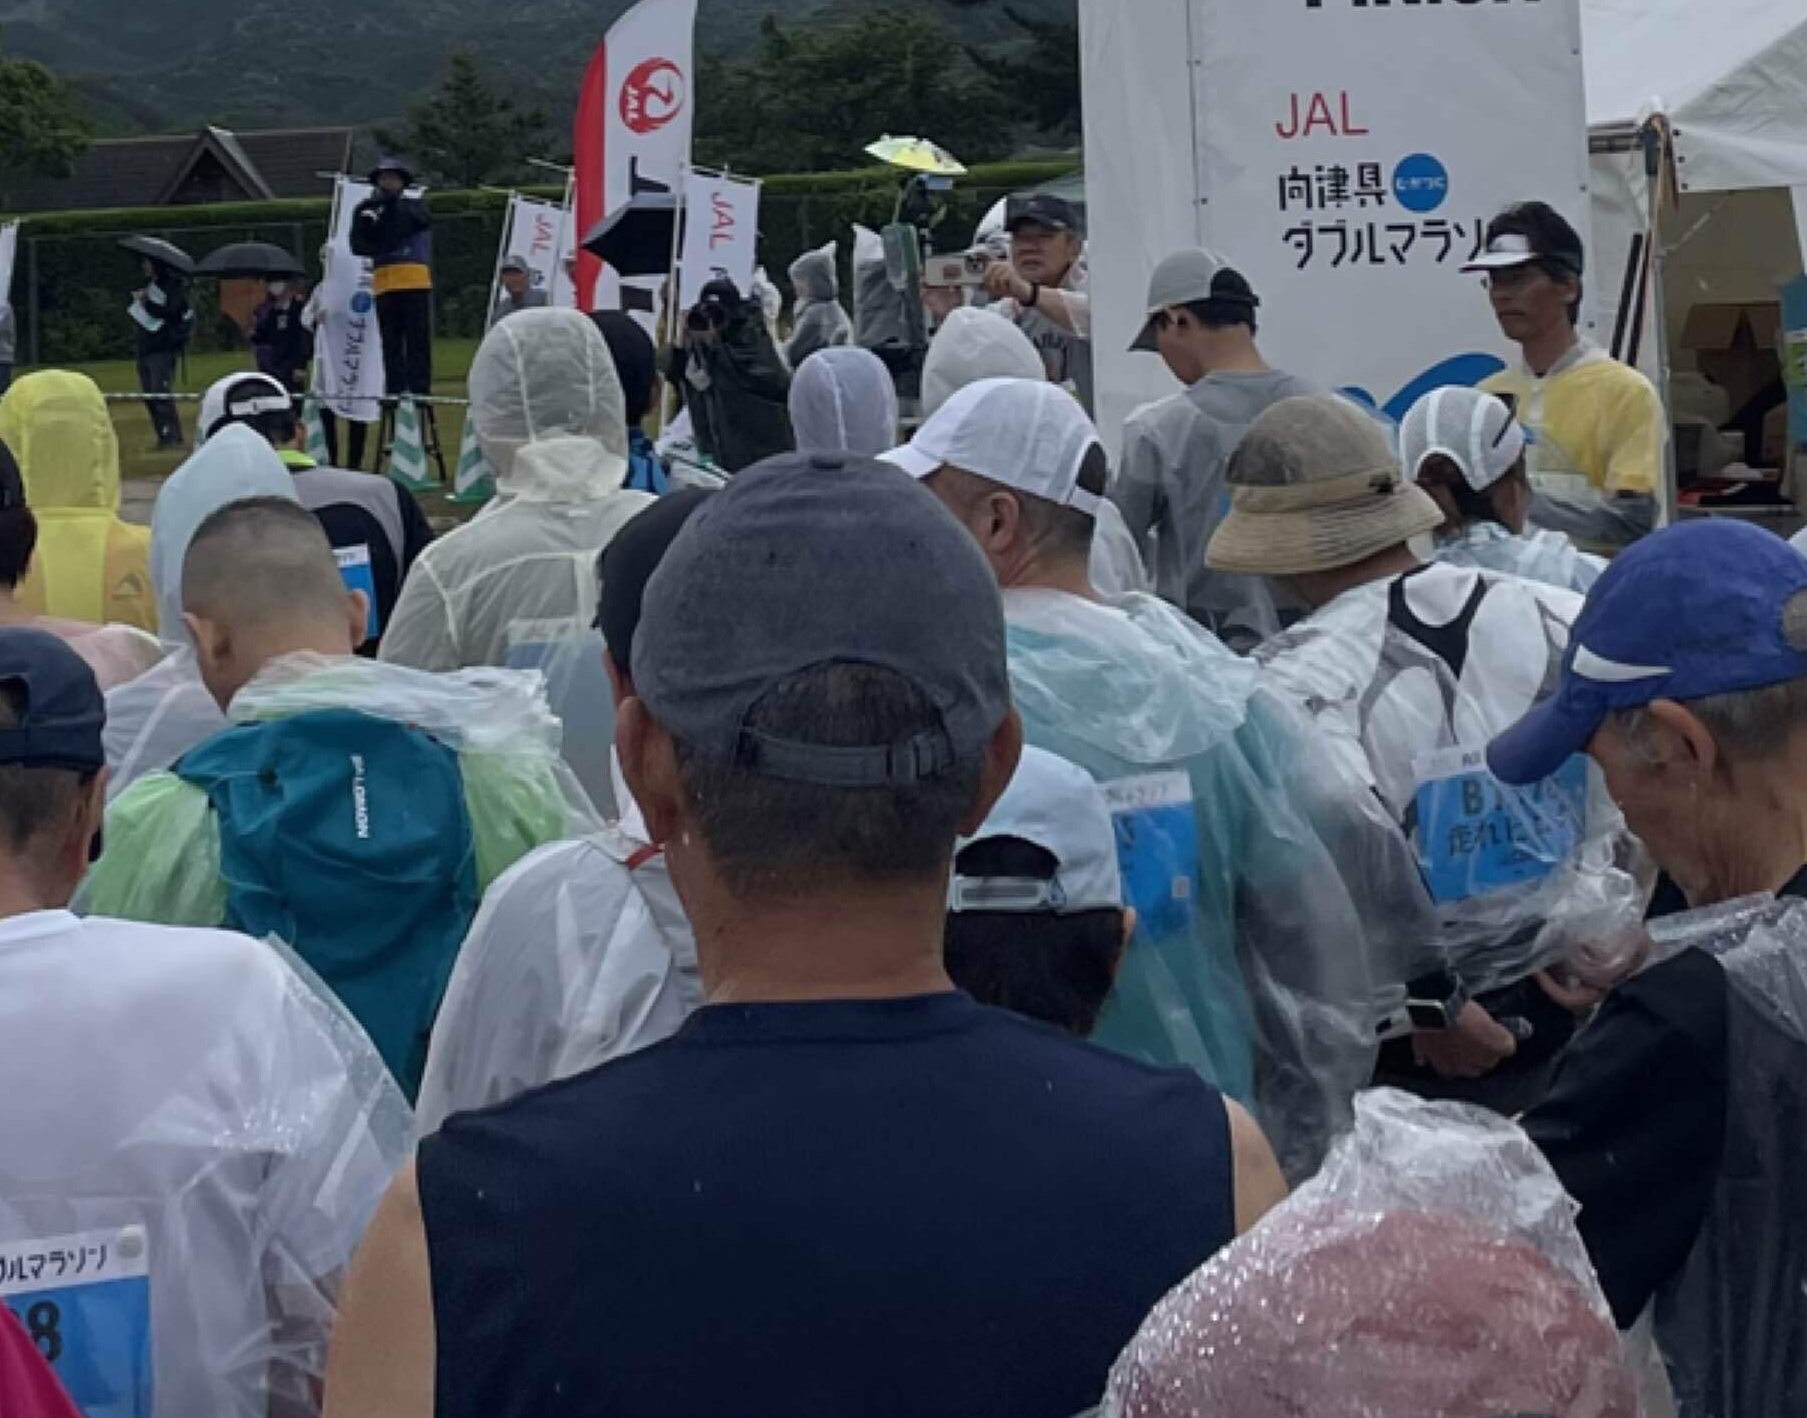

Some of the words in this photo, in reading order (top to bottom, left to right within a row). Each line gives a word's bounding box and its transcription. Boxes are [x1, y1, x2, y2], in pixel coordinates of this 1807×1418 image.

[1275, 90, 1370, 140] JAL
[1278, 161, 1388, 212] 向津具
[530, 212, 553, 256] JAL
[708, 191, 736, 251] JAL
[1281, 218, 1484, 270] ダブルマラソ
